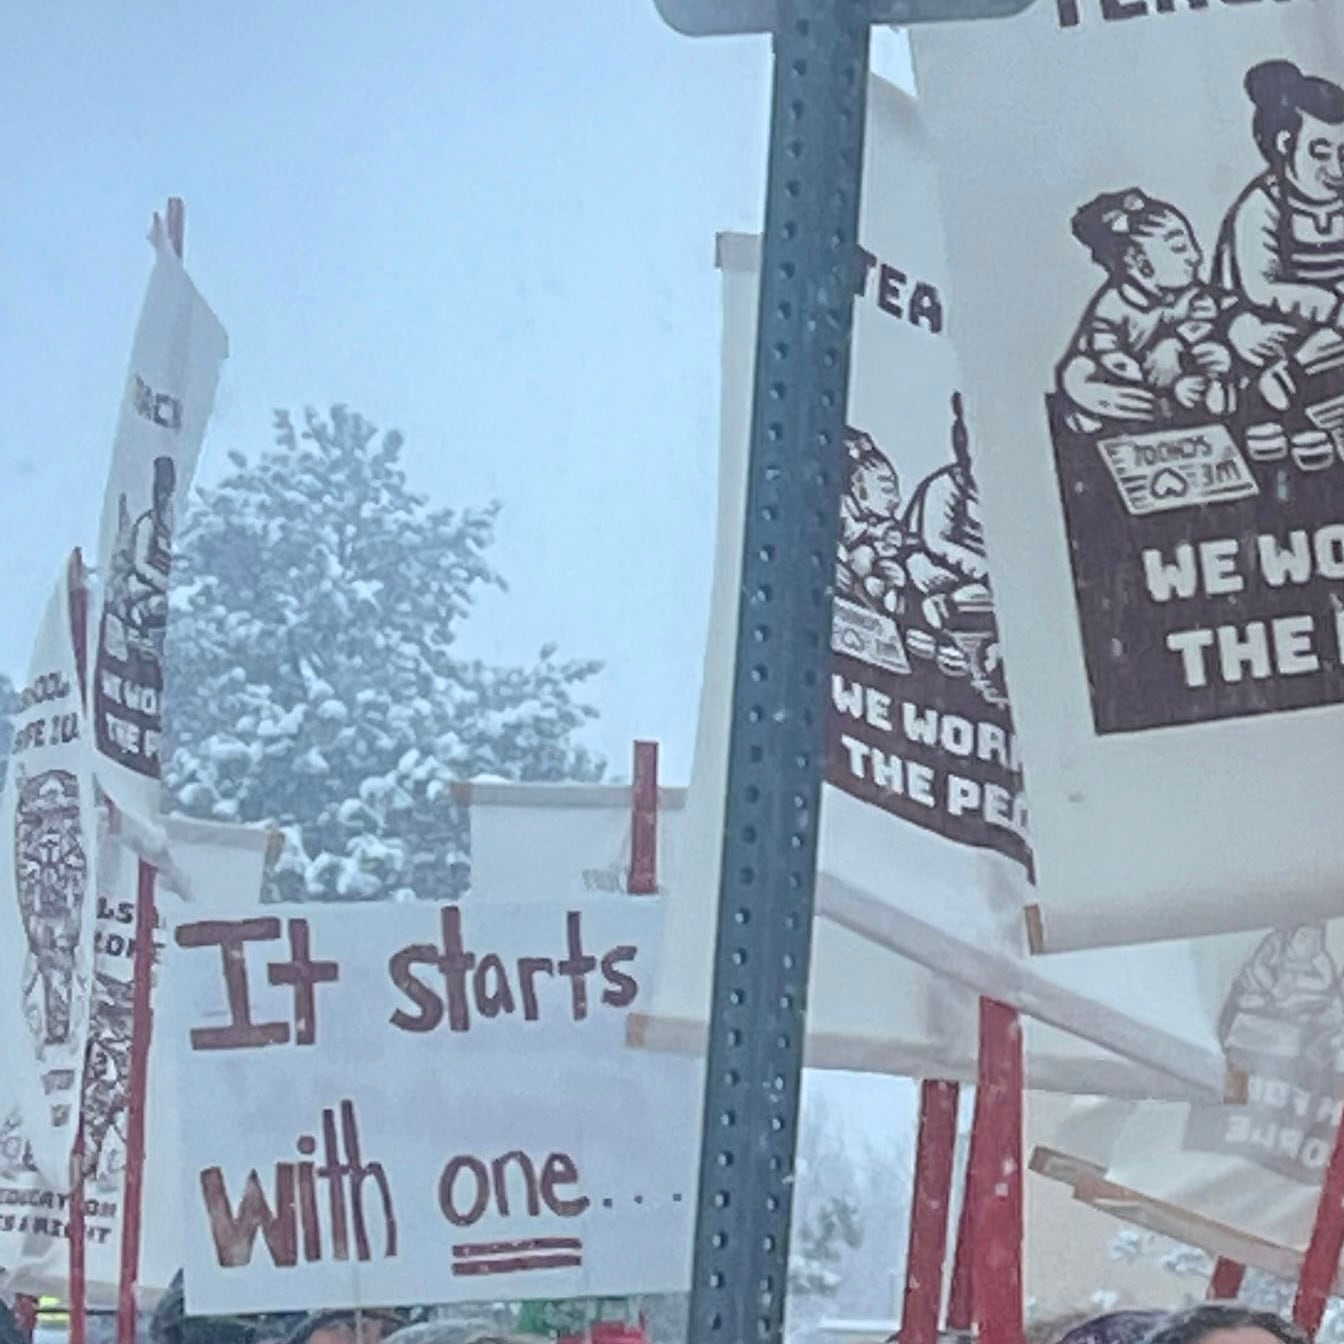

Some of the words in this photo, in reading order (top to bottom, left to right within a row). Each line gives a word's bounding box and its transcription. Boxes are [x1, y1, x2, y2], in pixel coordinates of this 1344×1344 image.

[1142, 540, 1245, 602] WE
[1166, 615, 1321, 687] THE
[831, 674, 893, 731] WE
[841, 734, 936, 808] THE
[174, 917, 340, 1051] It
[388, 905, 639, 1034] starts
[199, 1099, 398, 1271] with
